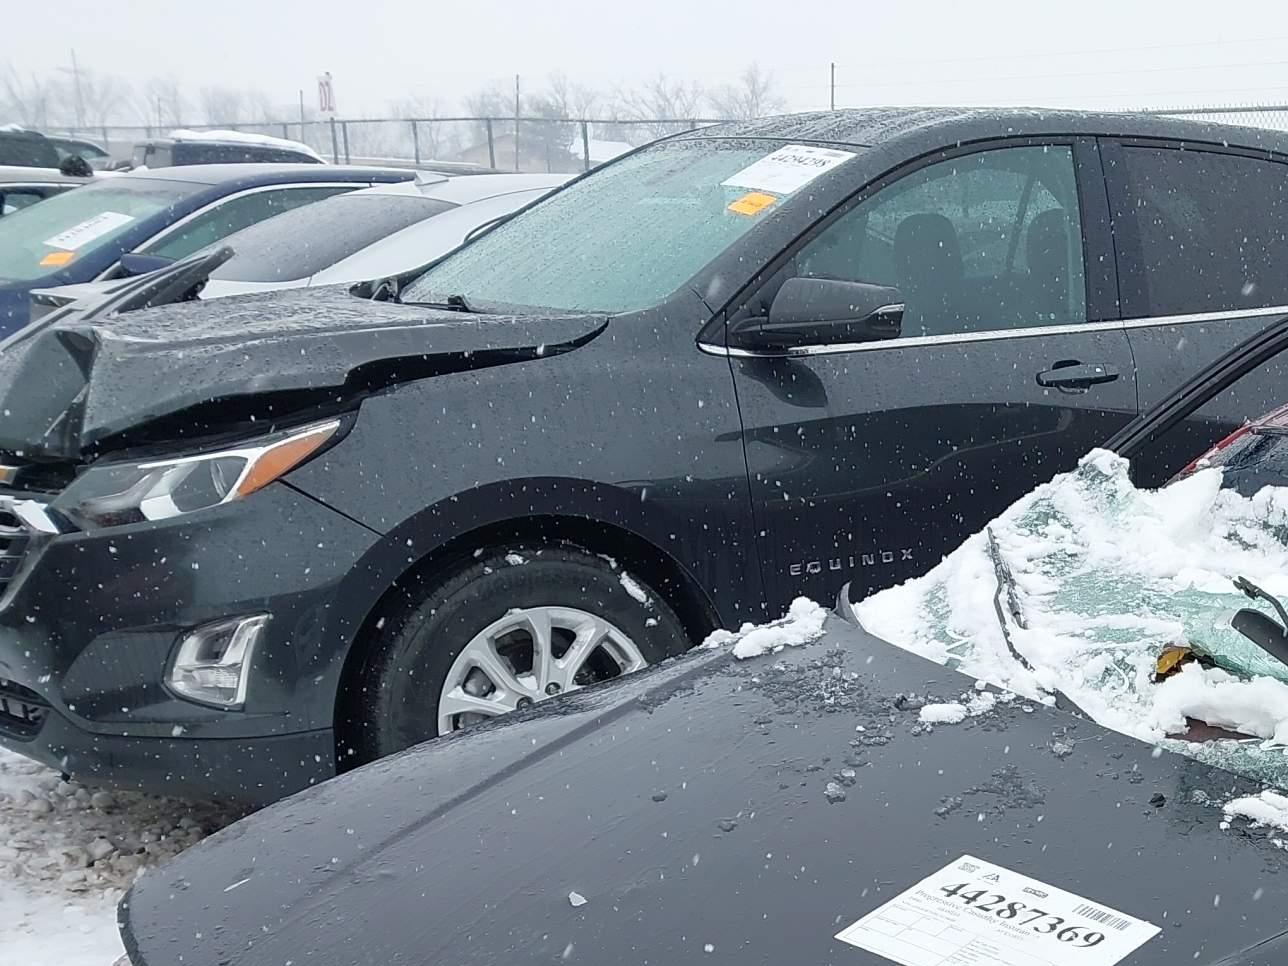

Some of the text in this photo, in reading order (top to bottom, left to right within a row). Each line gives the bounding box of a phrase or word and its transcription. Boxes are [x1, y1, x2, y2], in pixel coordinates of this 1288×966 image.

[790, 549, 913, 575] EQUINOX
[914, 889, 962, 911] Progressive
[963, 906, 999, 924] Casualty
[940, 882, 1106, 948] 44287369
